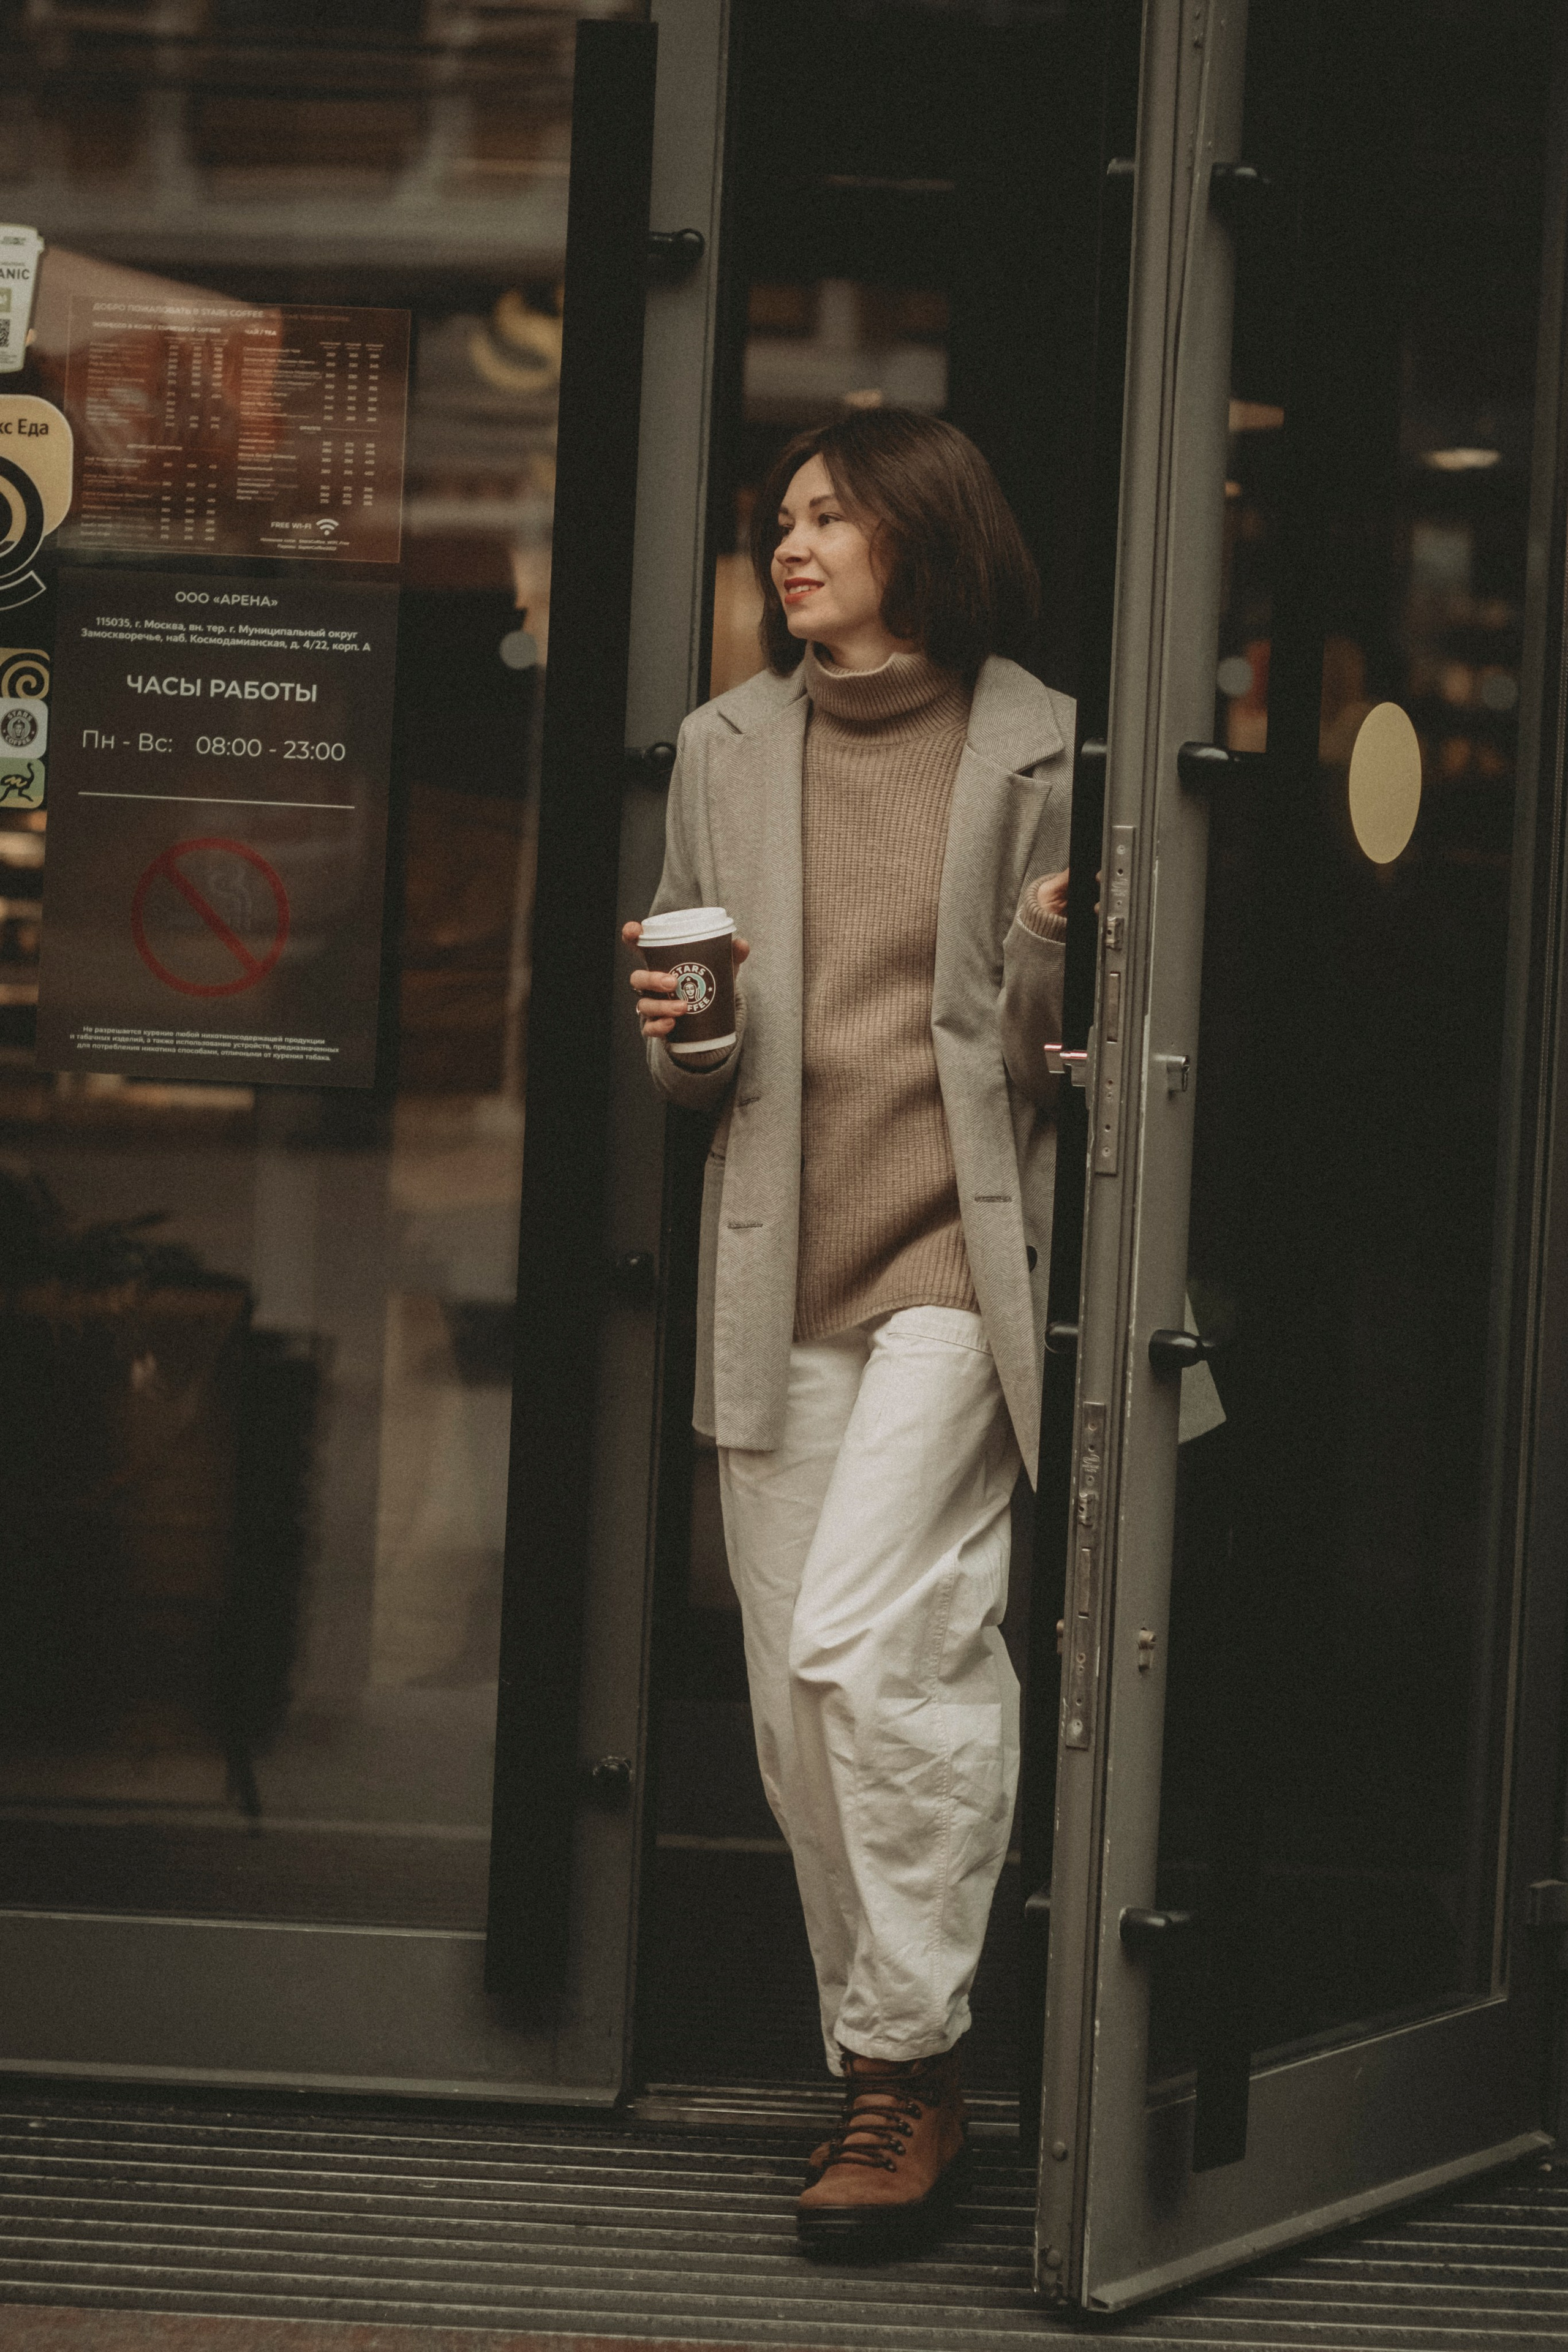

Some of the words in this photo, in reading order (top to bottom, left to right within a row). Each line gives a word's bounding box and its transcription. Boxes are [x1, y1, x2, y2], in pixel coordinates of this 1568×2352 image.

[18, 418, 48, 437] Еда
[175, 591, 209, 603] ООО
[213, 594, 278, 607] «АРЕНА»
[96, 617, 132, 628] 115035,
[144, 620, 186, 631] Москва,
[206, 625, 227, 635] тер.
[238, 625, 325, 637] Муниципальный
[328, 630, 358, 641] округ
[81, 628, 164, 643] Замоскворечье,
[166, 633, 187, 643] наб.
[190, 635, 287, 649] Космодамианская,
[290, 641, 300, 650] д.
[303, 640, 330, 651] 4/22,
[332, 643, 360, 653] корп.
[362, 643, 371, 652] А
[127, 674, 202, 696] ЧАСЫ
[210, 679, 317, 703] РАБОТЫ
[7, 710, 32, 722] STARS
[6, 735, 31, 746] COFFEE
[83, 729, 115, 749] Пн
[138, 733, 173, 753] Вс:
[195, 736, 262, 757] 08:00
[283, 740, 346, 761] 23:00
[672, 965, 706, 978] STARS
[687, 997, 710, 1011] FFEE
[201, 1033, 282, 1042] никотиносодержащей
[273, 1044, 339, 1053] предназначенных
